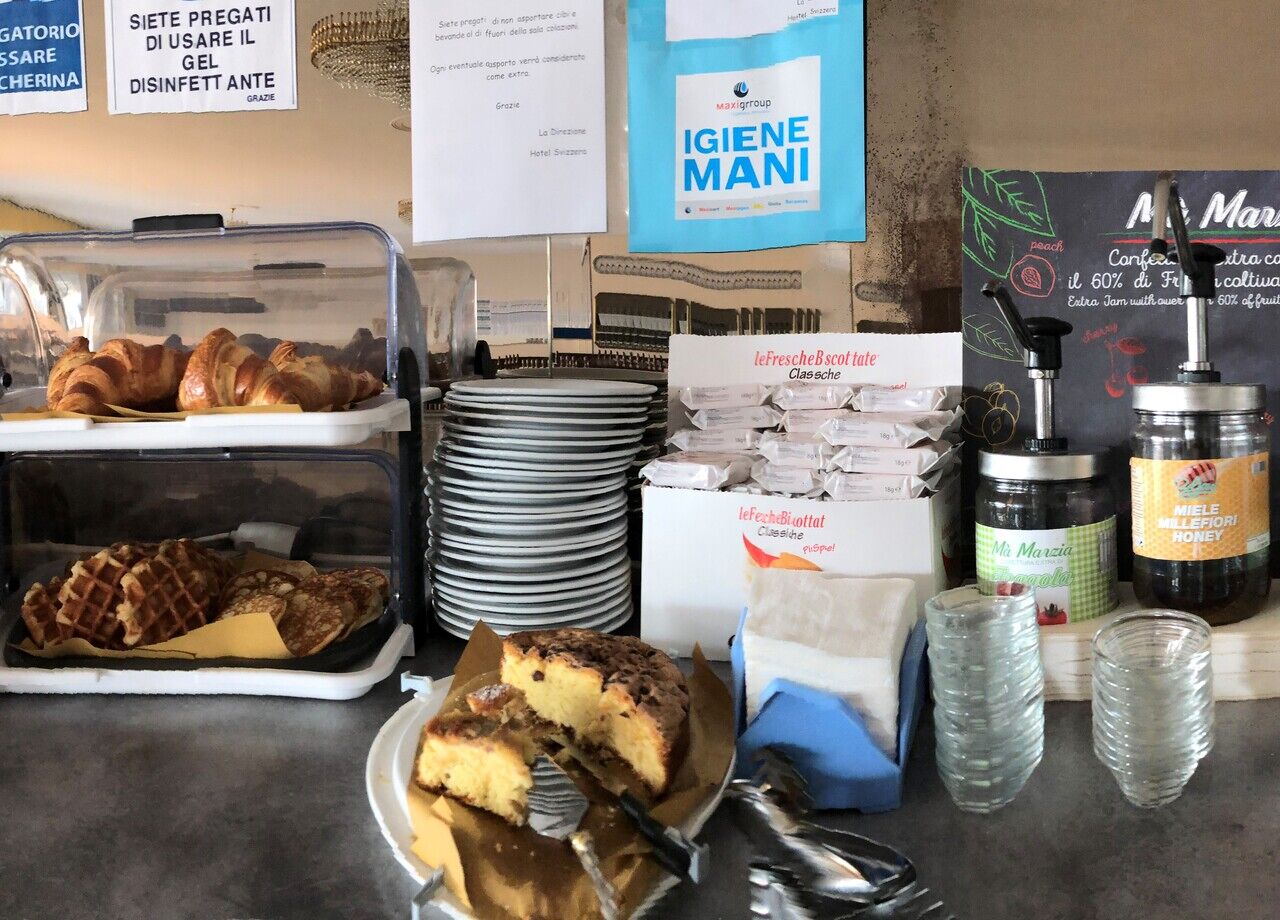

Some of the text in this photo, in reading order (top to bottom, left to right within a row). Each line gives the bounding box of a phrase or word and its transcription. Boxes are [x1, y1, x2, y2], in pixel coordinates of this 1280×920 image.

[129, 6, 270, 30] SIETE PREGATI
[438, 20, 458, 29] Siete
[460, 17, 487, 27] pregati
[517, 13, 554, 23] asportare
[146, 29, 255, 51] DI USARE IL
[435, 32, 465, 41] bevande
[182, 53, 218, 70] GEL
[448, 61, 483, 71] eventuale
[486, 73, 505, 81] come
[246, 93, 275, 102] GRAZIE
[495, 102, 520, 110] Grazie
[684, 116, 809, 154] IGIENE
[529, 148, 551, 157] Hotel
[684, 147, 809, 191] MANI
[1029, 239, 1064, 253] peach
[1067, 272, 1082, 289] il
[1091, 272, 1123, 289] 60%
[1133, 271, 1152, 288] di
[1067, 296, 1099, 307] Extra
[1130, 294, 1157, 305] with
[1157, 297, 1185, 306] over
[1217, 294, 1238, 306] 60%
[1241, 293, 1255, 308] of
[1174, 504, 1220, 516] MIELE
[1158, 515, 1237, 529] MILLEFIORI
[1172, 529, 1224, 543] HONEY
[991, 541, 1073, 558] Mà Marzia
